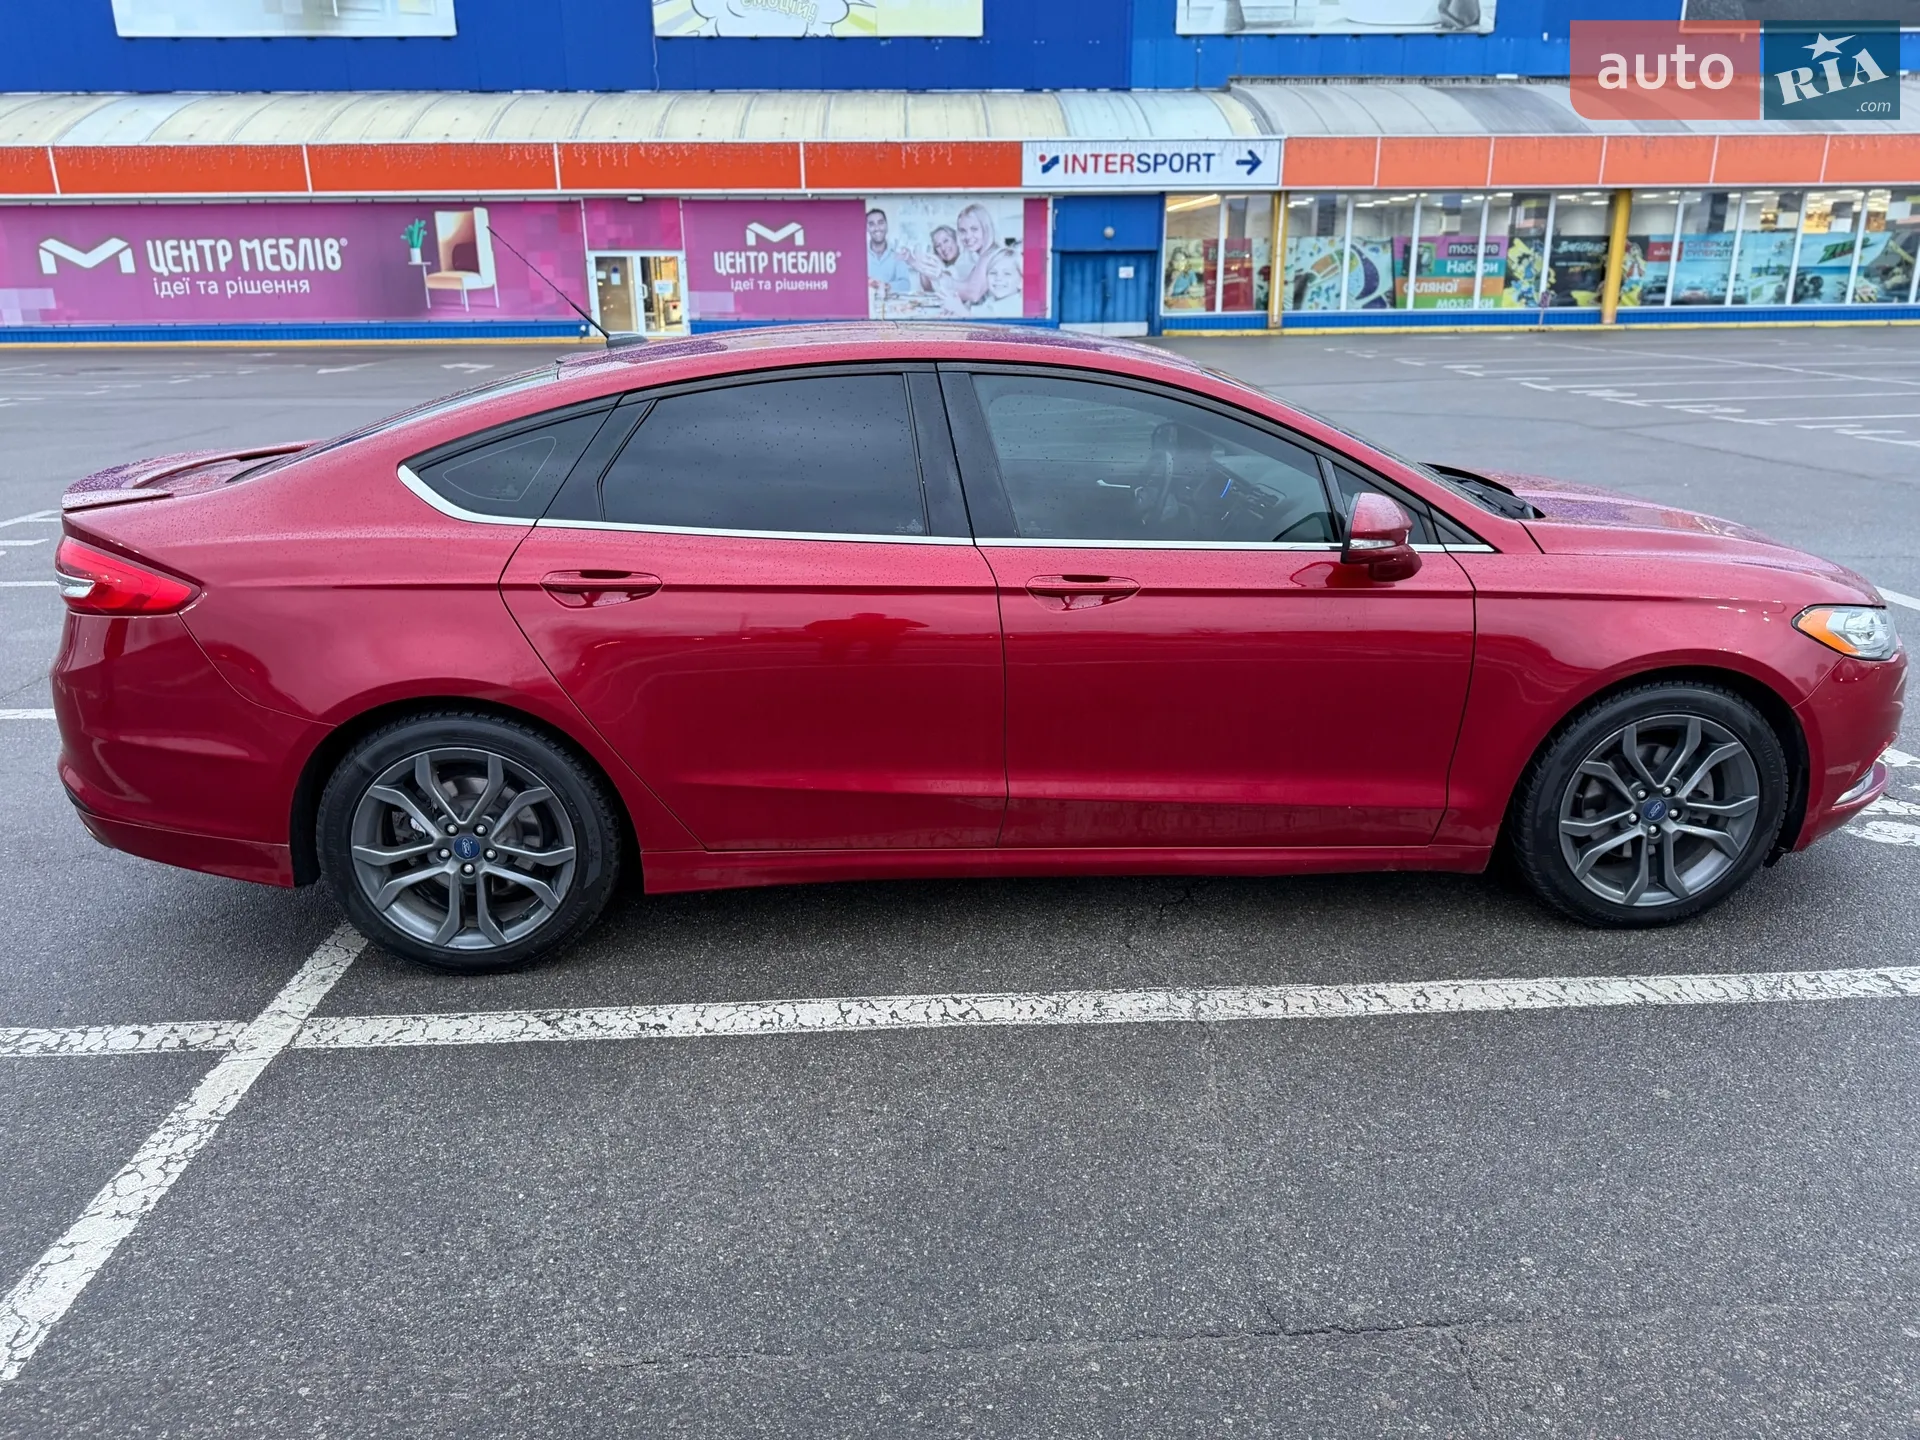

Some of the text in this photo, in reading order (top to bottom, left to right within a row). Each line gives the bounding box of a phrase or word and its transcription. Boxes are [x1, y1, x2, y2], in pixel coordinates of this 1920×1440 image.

[1063, 153, 1216, 174] INTERSPORT
[146, 238, 233, 276] ЦЕНТР
[713, 251, 768, 276] ЦЕНТР
[1446, 260, 1499, 273] Набри
[153, 276, 310, 299] ідеї та рішення
[730, 278, 828, 293] ідеї та рішення
[1436, 298, 1495, 309] мозаки
